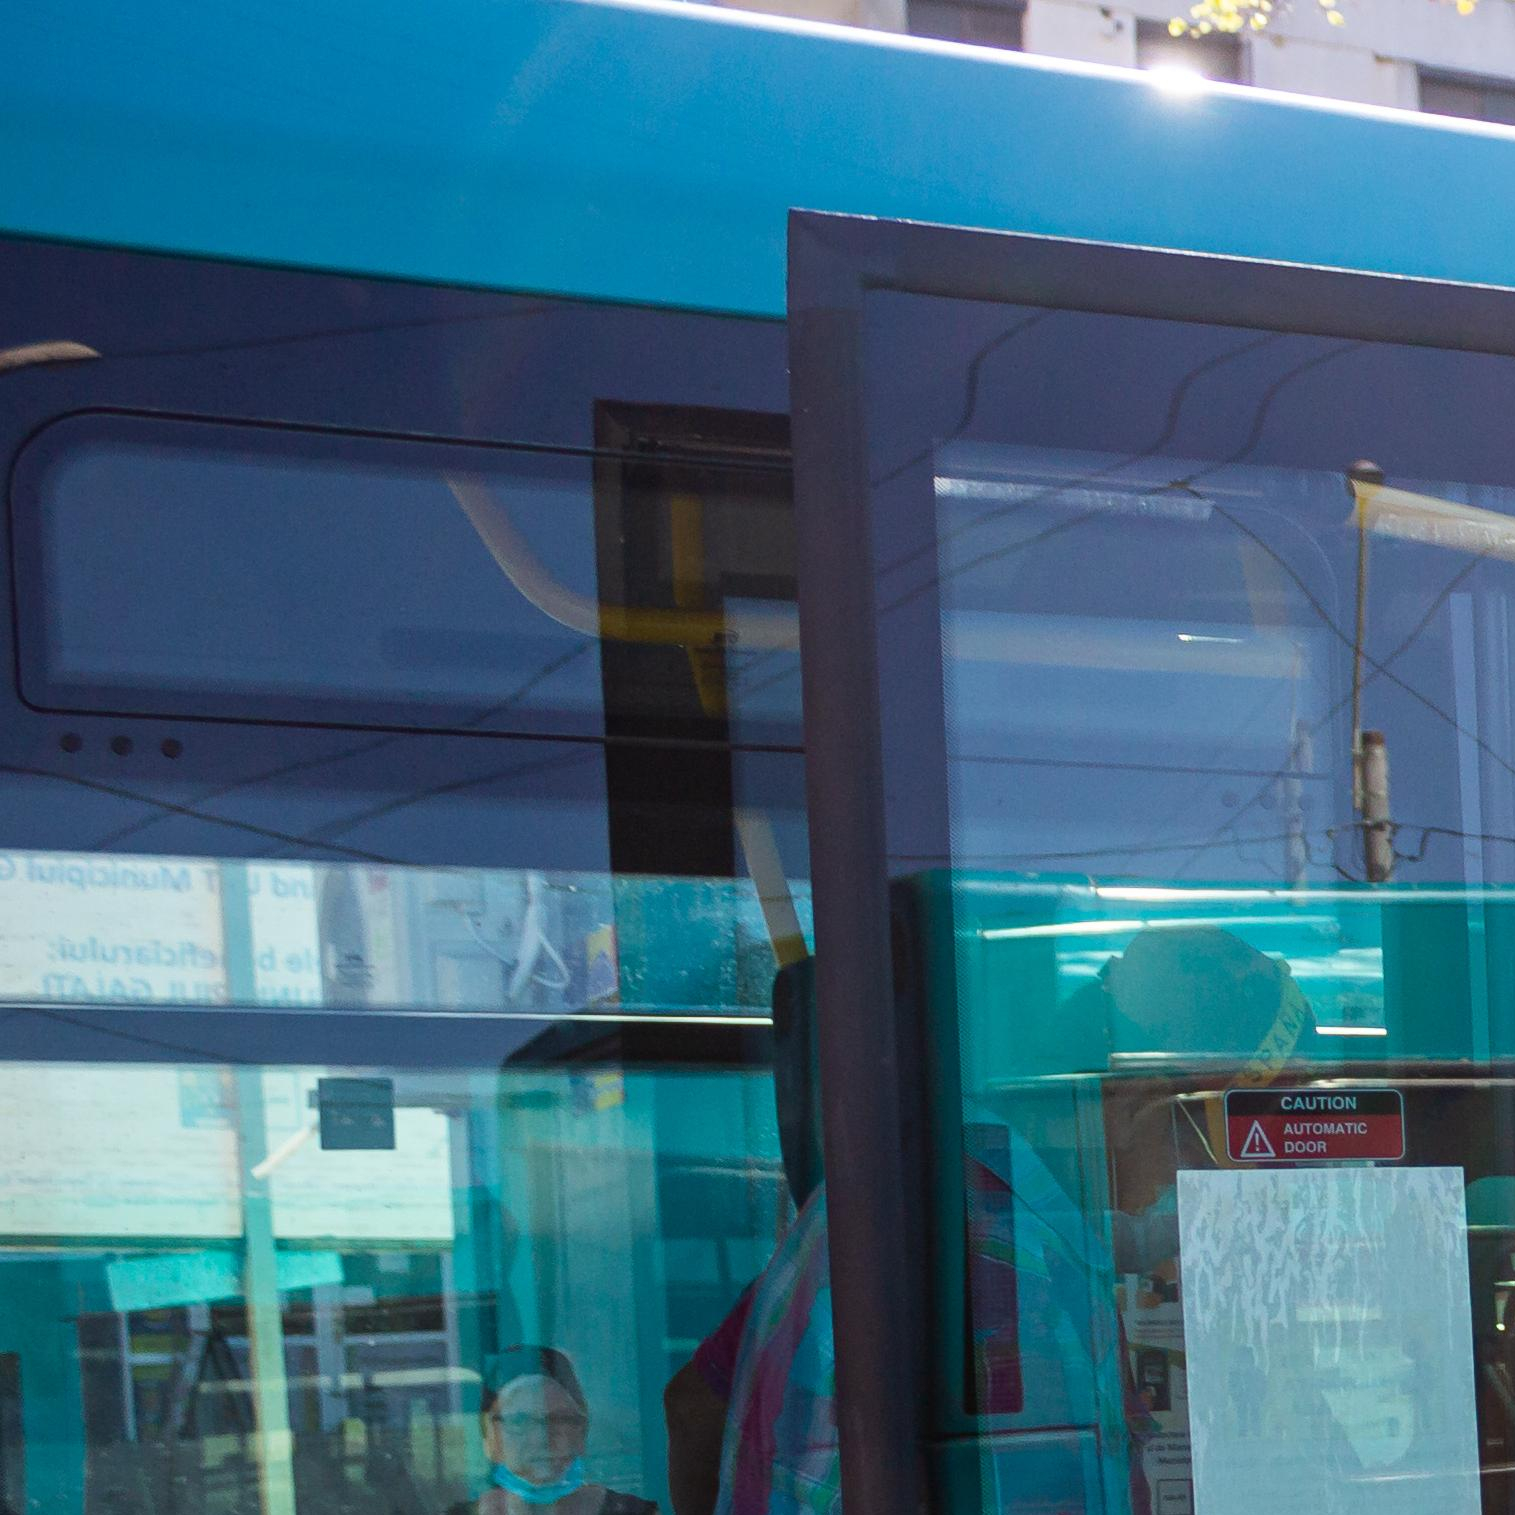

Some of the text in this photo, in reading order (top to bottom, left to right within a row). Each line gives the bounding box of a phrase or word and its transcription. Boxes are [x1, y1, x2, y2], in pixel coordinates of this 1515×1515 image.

[1280, 1096, 1357, 1110] CAUTION
[1283, 1122, 1368, 1135] AUTOMATIC
[1284, 1141, 1327, 1153] DOOR
